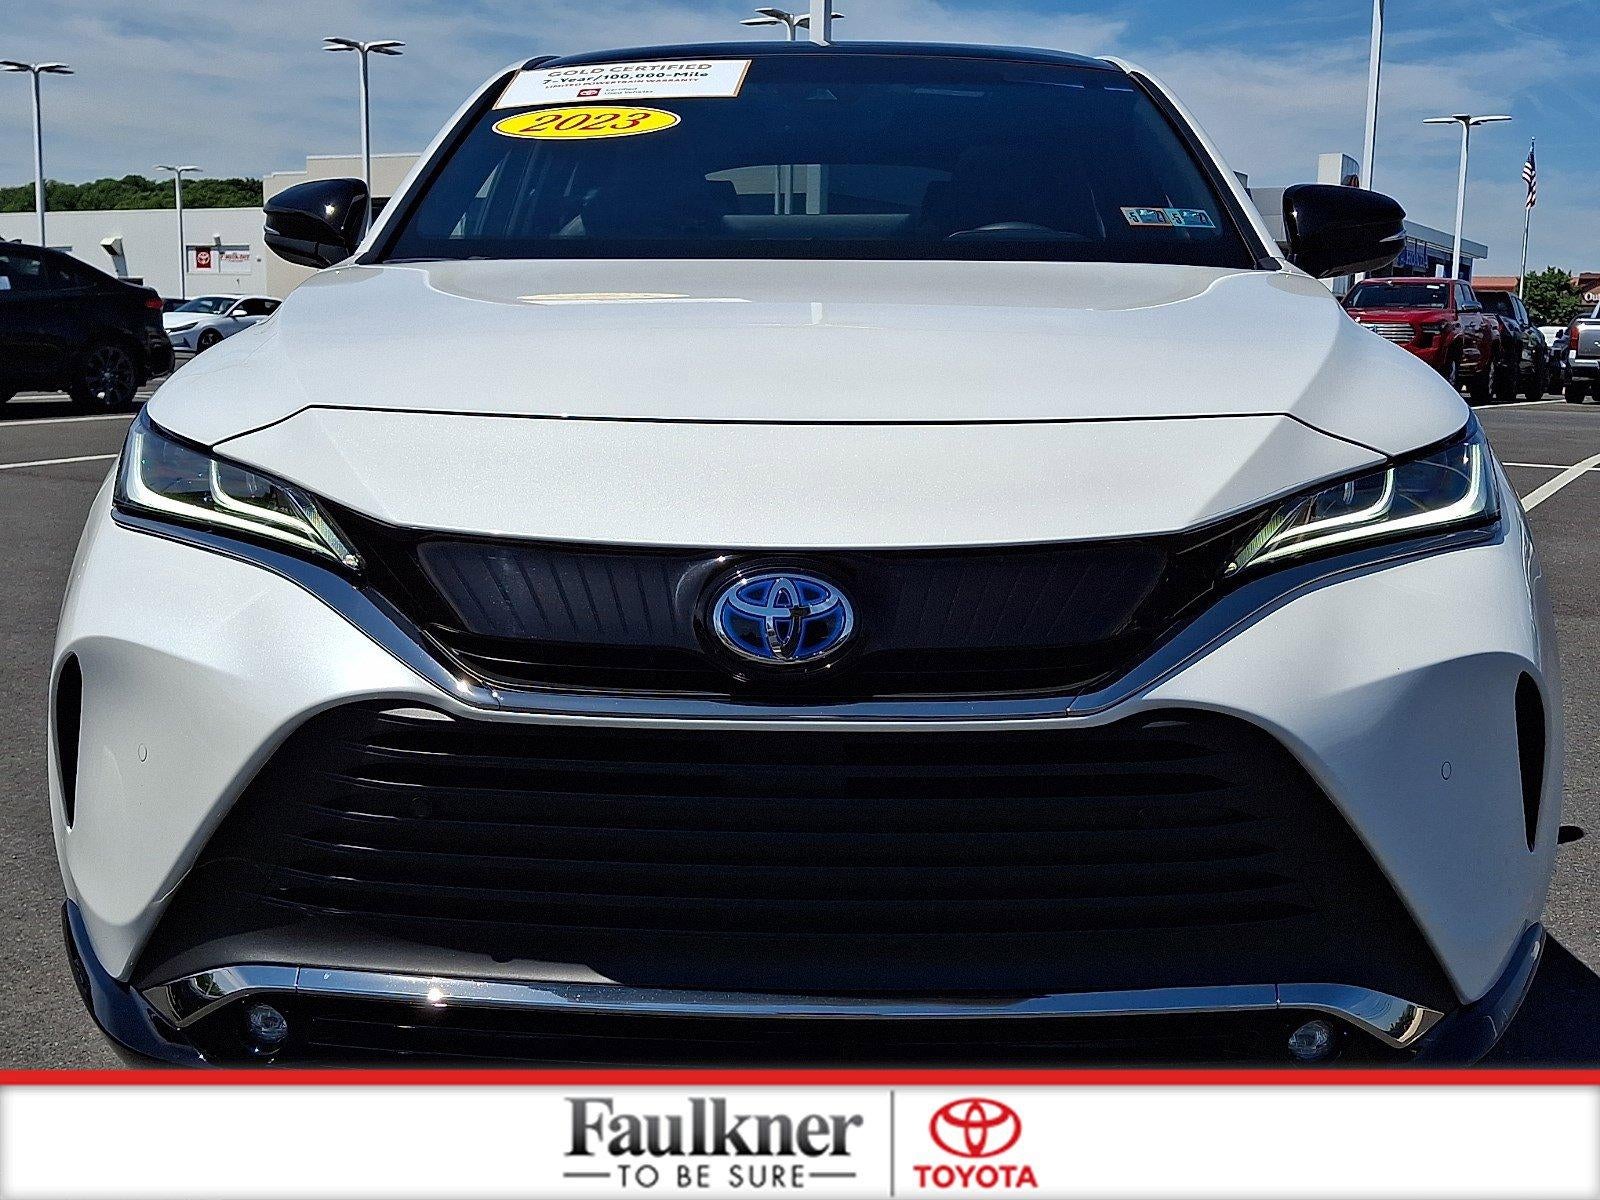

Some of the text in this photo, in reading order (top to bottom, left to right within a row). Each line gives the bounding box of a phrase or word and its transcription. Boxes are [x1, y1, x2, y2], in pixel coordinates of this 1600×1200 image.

[547, 63, 712, 77] GOLD CERTIFIED
[542, 71, 709, 85] 7-Year/100,000-Mile
[519, 112, 652, 133] 2023
